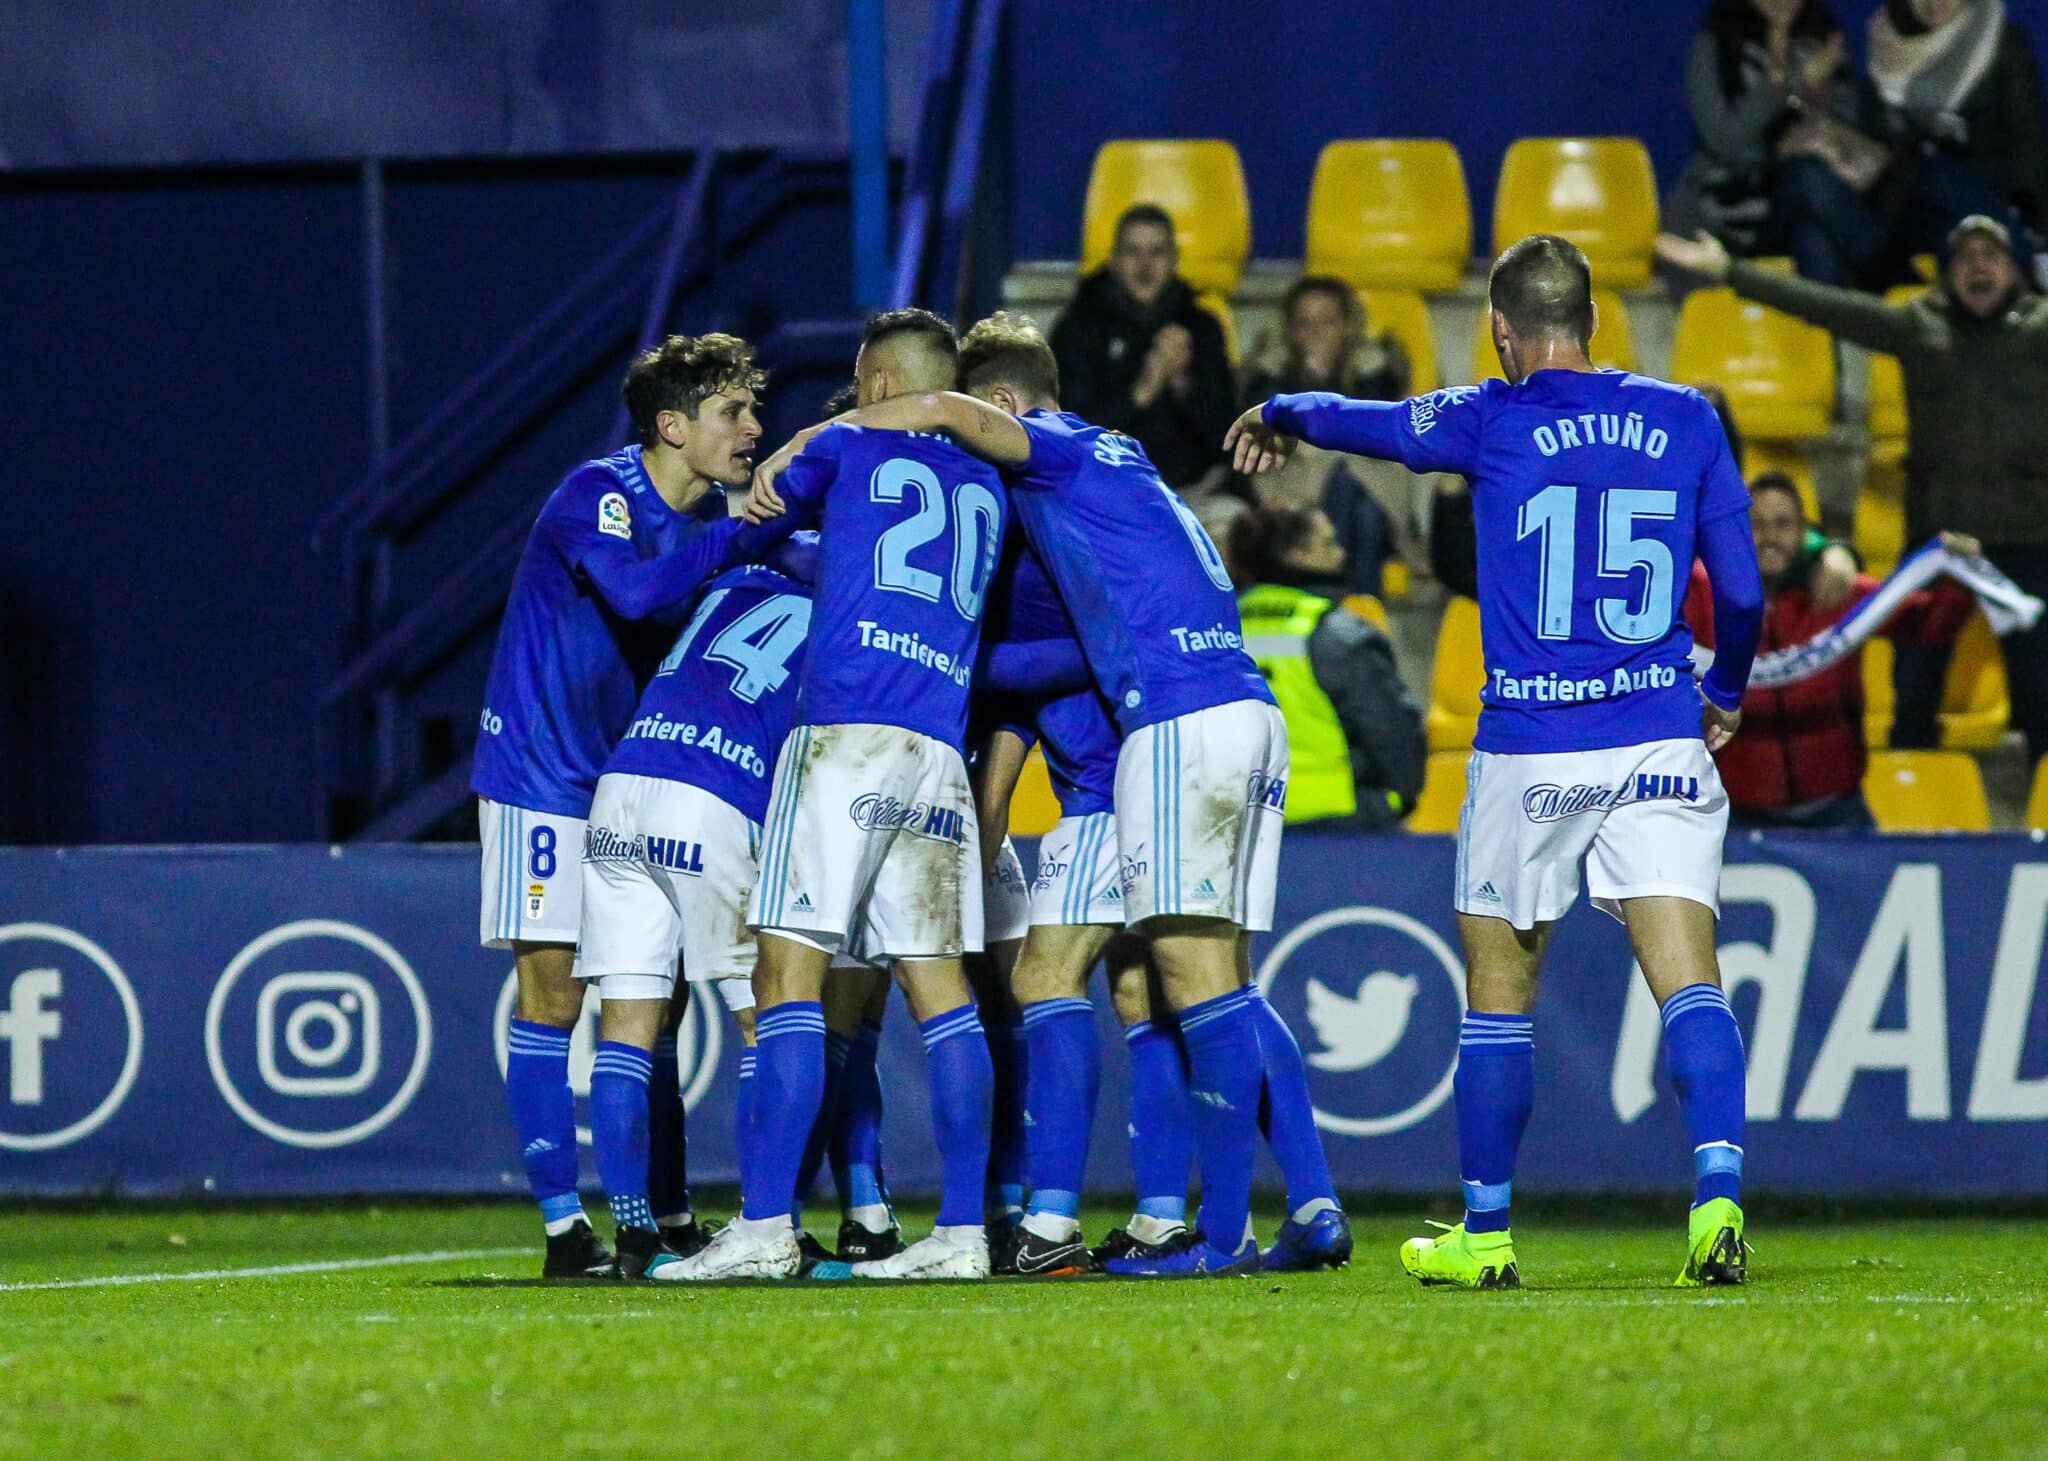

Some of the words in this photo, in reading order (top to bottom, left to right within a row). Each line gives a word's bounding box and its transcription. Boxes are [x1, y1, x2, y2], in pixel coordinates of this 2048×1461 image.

[1533, 411, 1669, 459] ORTUÑO
[870, 457, 1000, 622] 20
[1516, 485, 1677, 645] 15
[656, 588, 813, 704] 14
[1169, 623, 1242, 653] Tartie
[1493, 668, 1606, 701] Tartiere
[1610, 663, 1676, 696] Auto
[697, 726, 766, 779] Auto
[527, 825, 557, 881] 8
[646, 835, 704, 873] HILL
